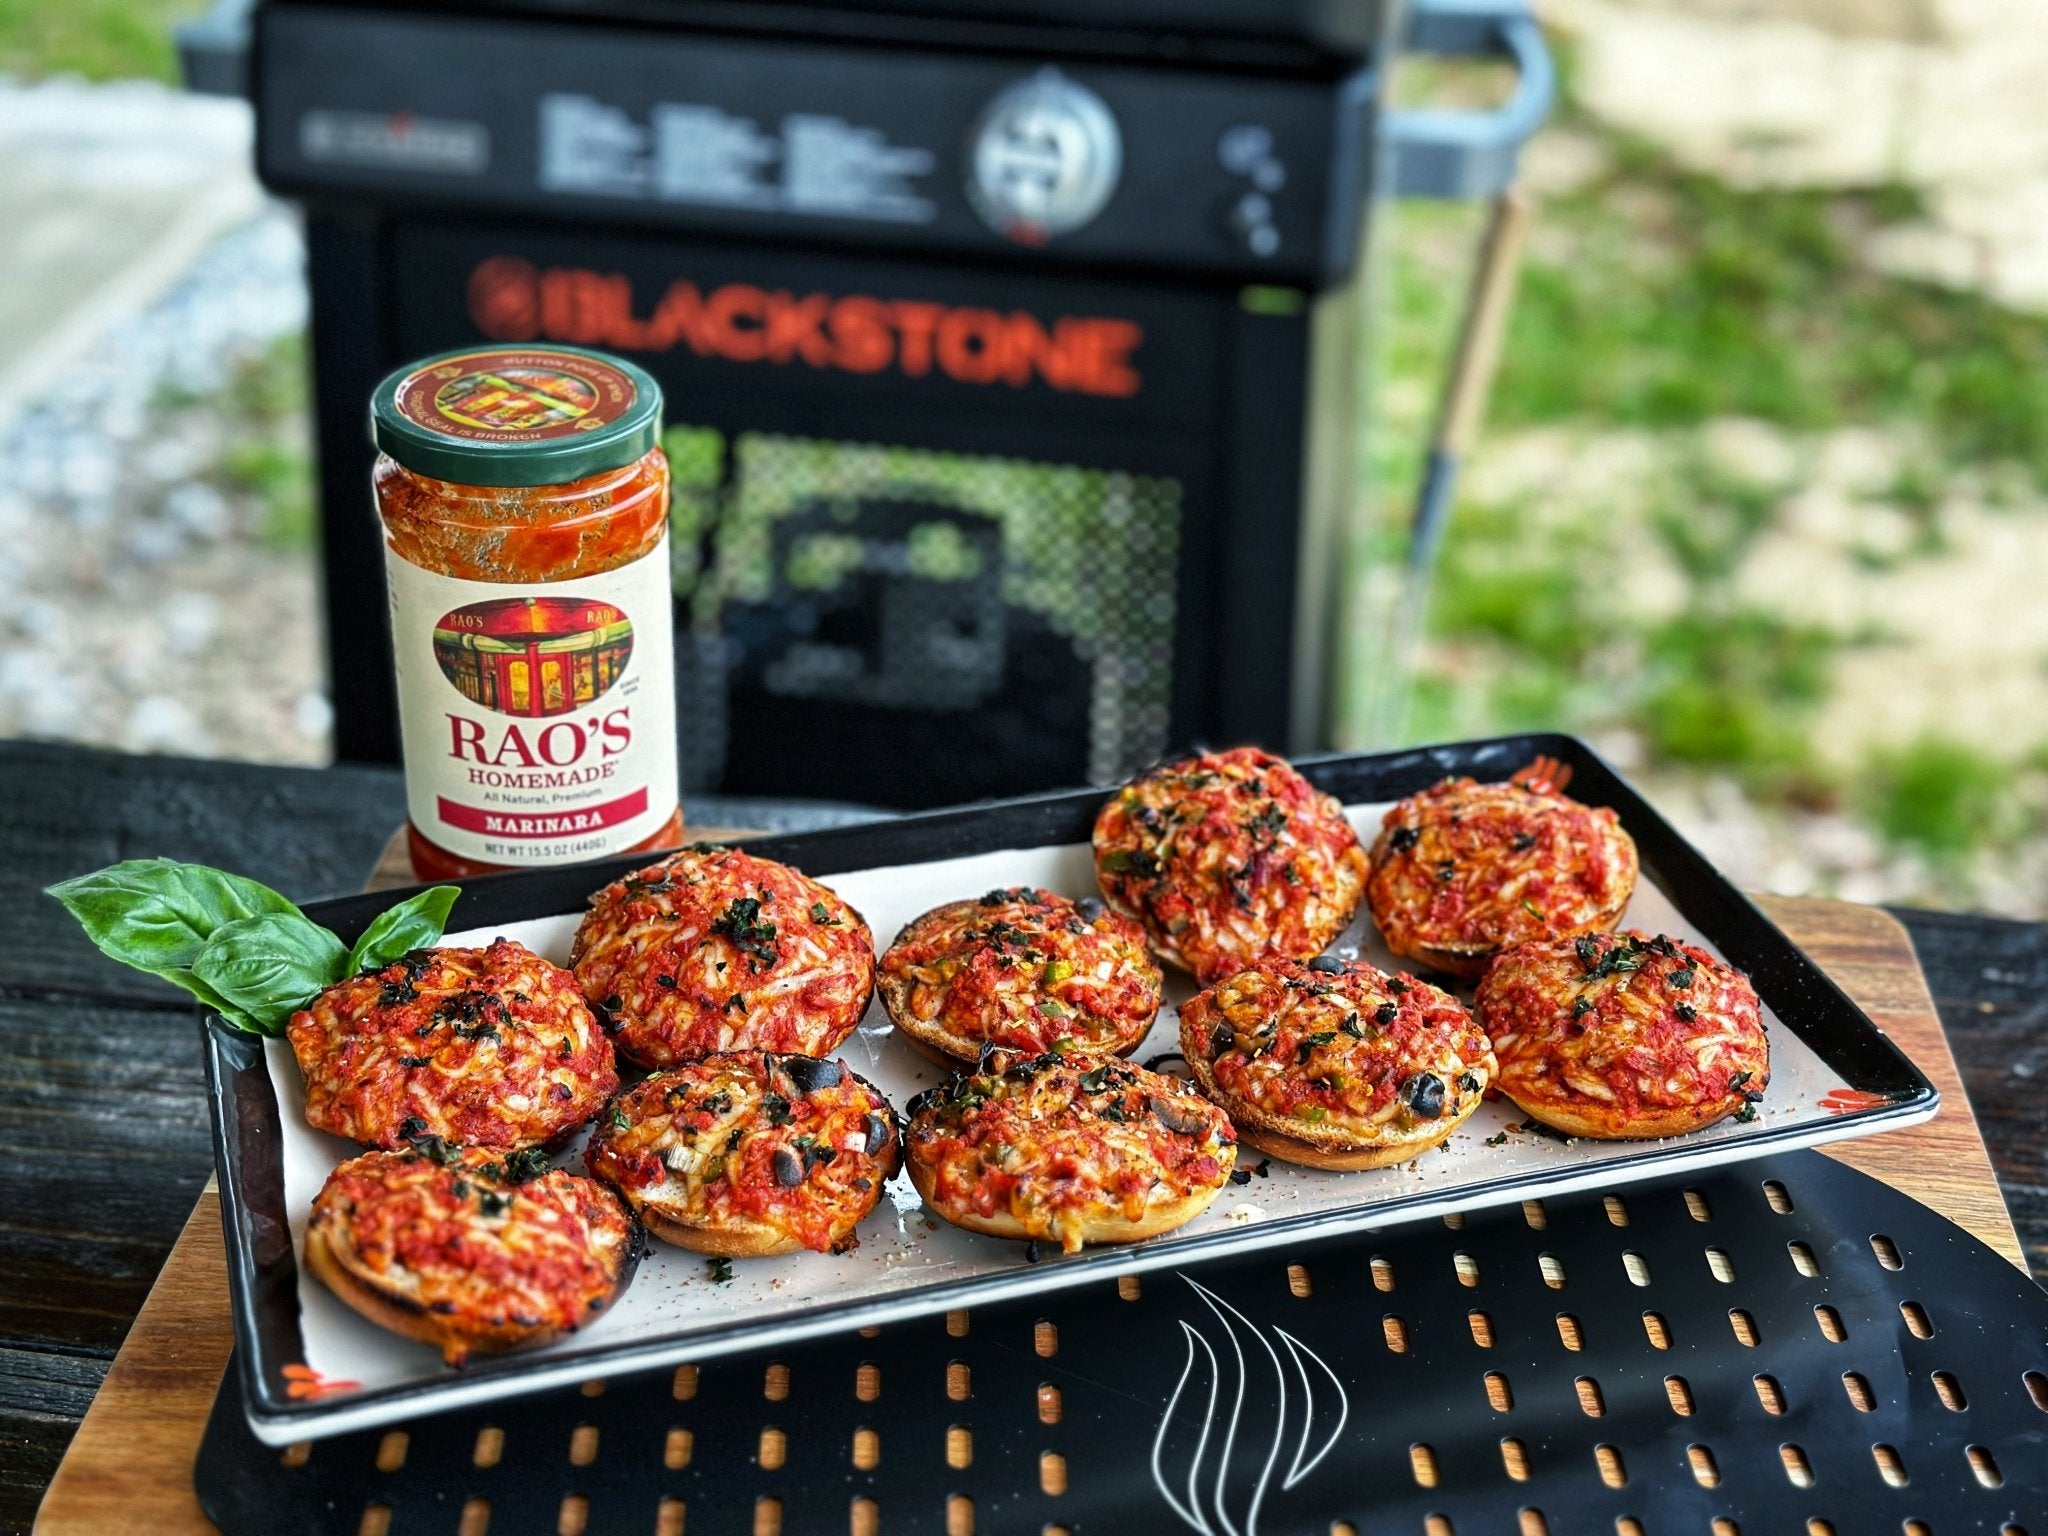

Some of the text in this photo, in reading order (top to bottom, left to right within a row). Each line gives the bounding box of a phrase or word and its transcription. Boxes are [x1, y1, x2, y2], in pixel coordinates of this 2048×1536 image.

[425, 416, 455, 433] SEAL
[458, 428, 472, 437] IS
[474, 432, 542, 440] BROKEN
[450, 613, 484, 628] RAO'S
[445, 706, 632, 768] RAO'S
[468, 762, 616, 789] HOMEMADE
[484, 788, 603, 805] All Natural, Premium
[485, 811, 604, 834] MARINARA
[485, 836, 607, 857] NET WT 15.5 OZ (440G)
